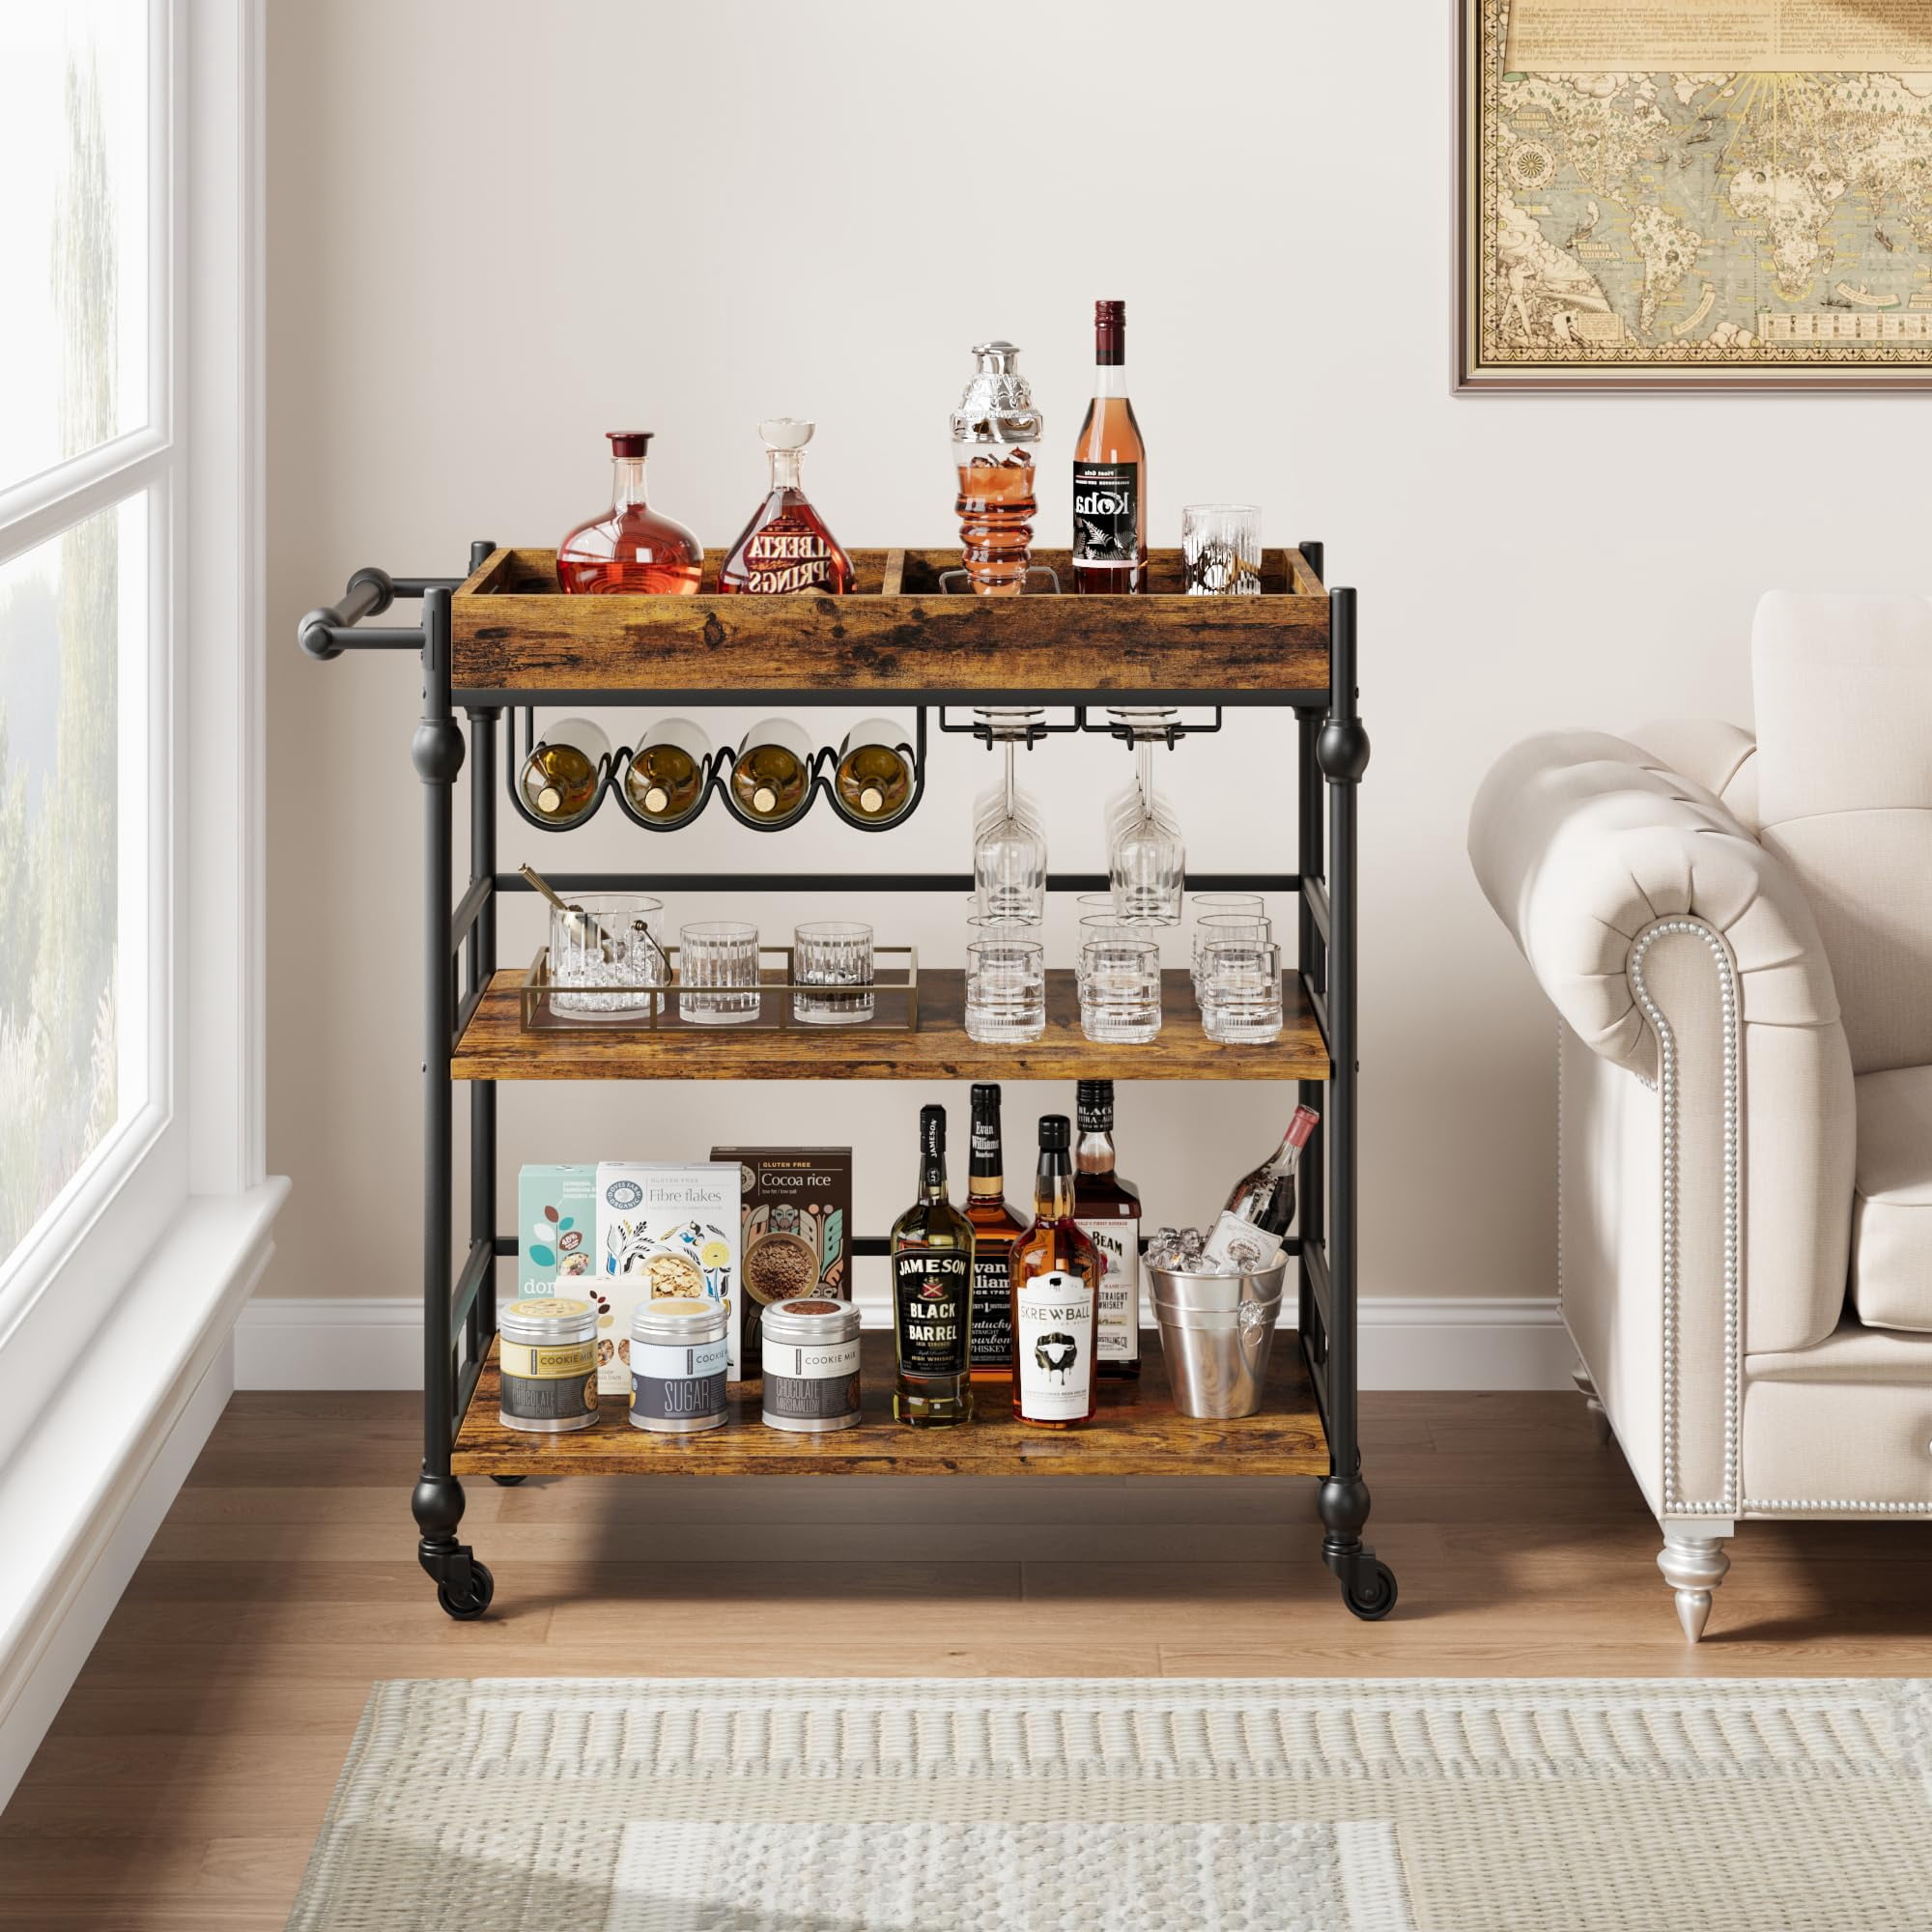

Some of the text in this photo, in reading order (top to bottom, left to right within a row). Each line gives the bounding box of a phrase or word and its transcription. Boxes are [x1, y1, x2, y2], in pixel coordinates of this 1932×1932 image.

[976, 1121, 994, 1135] Evan
[928, 1119, 938, 1158] JAMESON
[972, 1135, 1000, 1151] Williams
[761, 1173, 804, 1186] Cocoa
[807, 1173, 832, 1186] rice
[650, 1188, 723, 1203] Fibre flakes
[1093, 1231, 1122, 1258] BEAM
[899, 1259, 966, 1275] JAMESON
[974, 1263, 1008, 1274] van
[974, 1274, 1010, 1289] lliam
[1098, 1292, 1128, 1301] STRAIGHT
[910, 1302, 955, 1319] BLACK
[1098, 1301, 1123, 1310] WHISKEY
[1020, 1306, 1091, 1321] SKREWBALL
[972, 1319, 1012, 1331] entucky
[908, 1324, 957, 1341] BARREL
[971, 1334, 1011, 1345] ourbon
[971, 1345, 1007, 1353] HISKEY
[540, 1355, 579, 1365] COOKIE
[696, 1351, 724, 1364] COOKIE
[805, 1354, 842, 1365] COOKIE
[664, 1379, 709, 1412] SUGAR
[776, 1377, 820, 1400] CHOCOLATE
